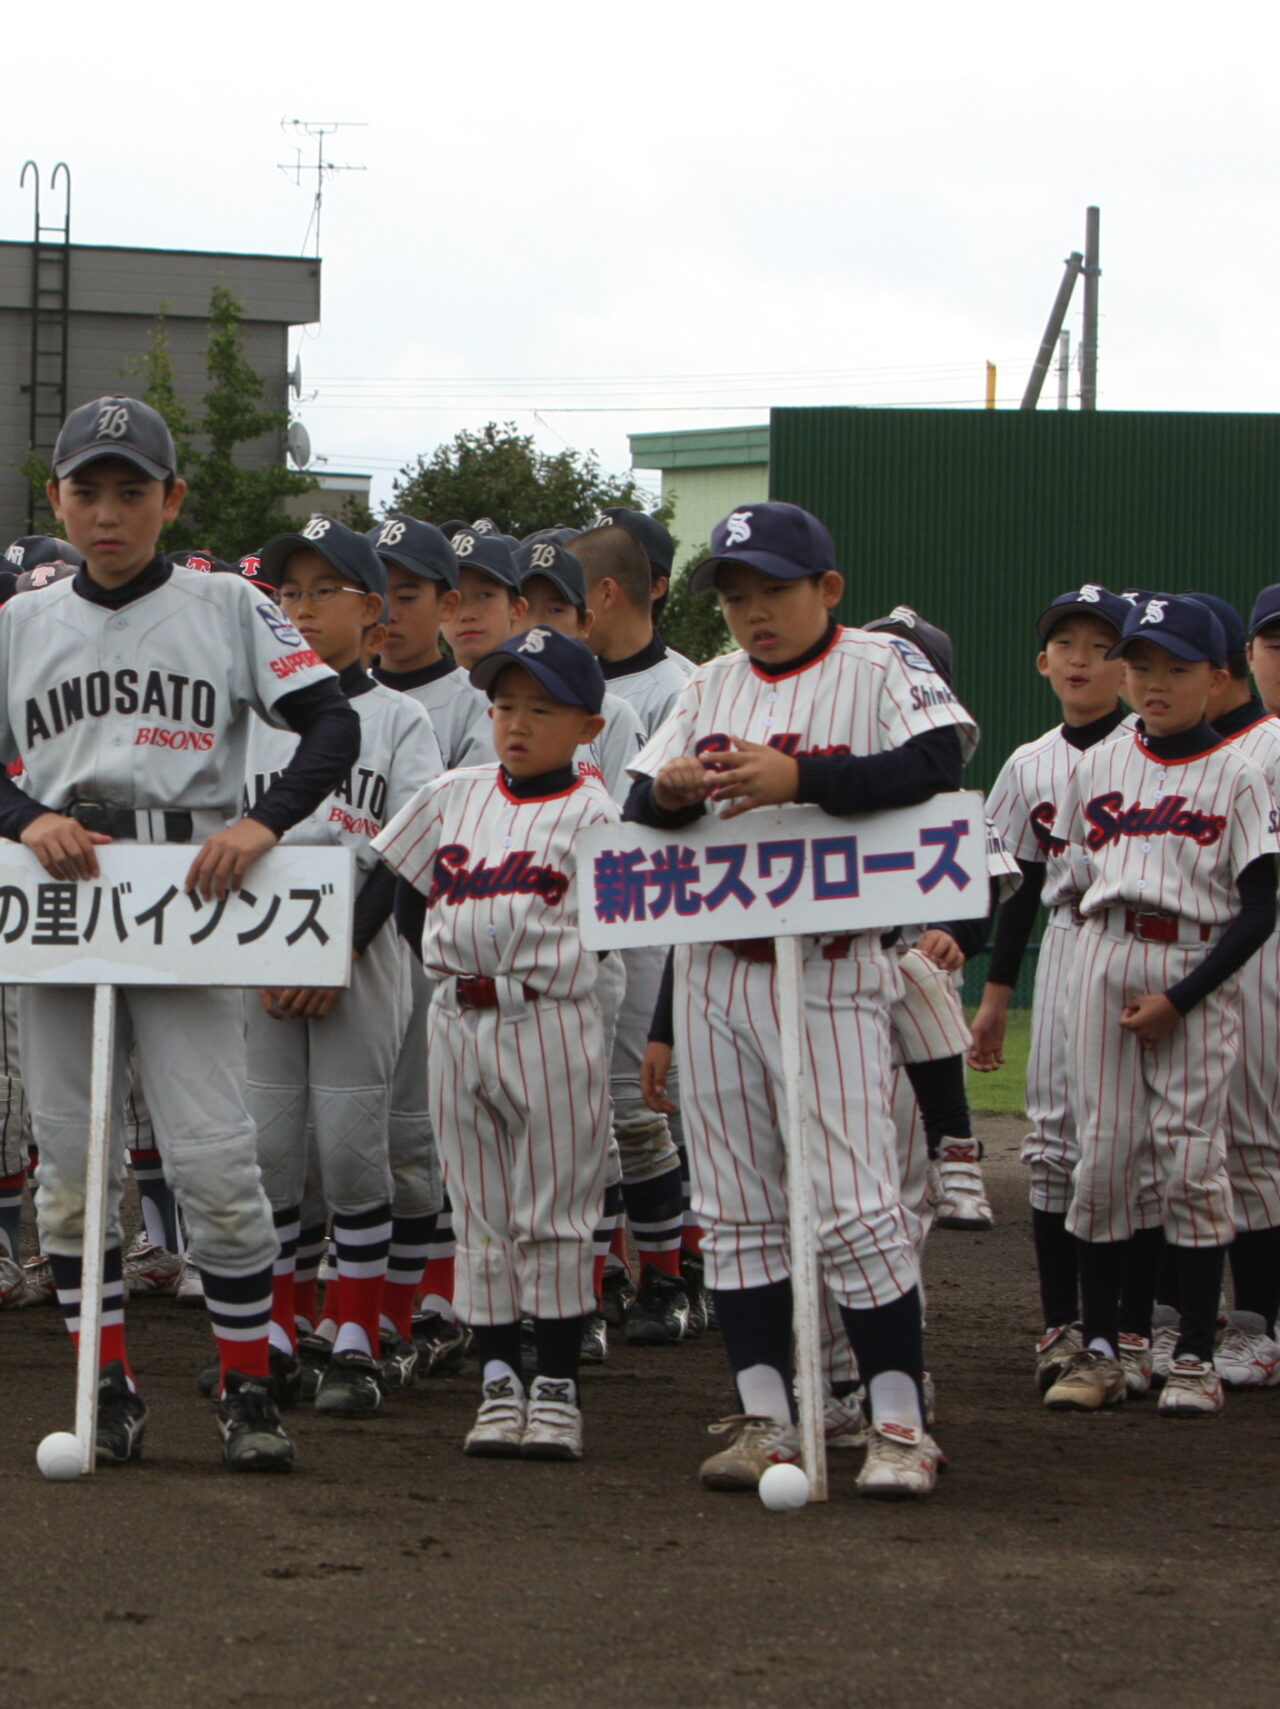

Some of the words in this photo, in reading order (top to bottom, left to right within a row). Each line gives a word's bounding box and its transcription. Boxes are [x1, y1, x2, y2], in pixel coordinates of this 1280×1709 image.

[724, 511, 753, 546] S
[30, 565, 56, 587] T
[239, 556, 261, 577] T
[1140, 600, 1169, 625] S
[24, 668, 217, 750] AINOSATO
[132, 727, 216, 751] BISONS
[593, 818, 972, 925] 新光スワローズ
